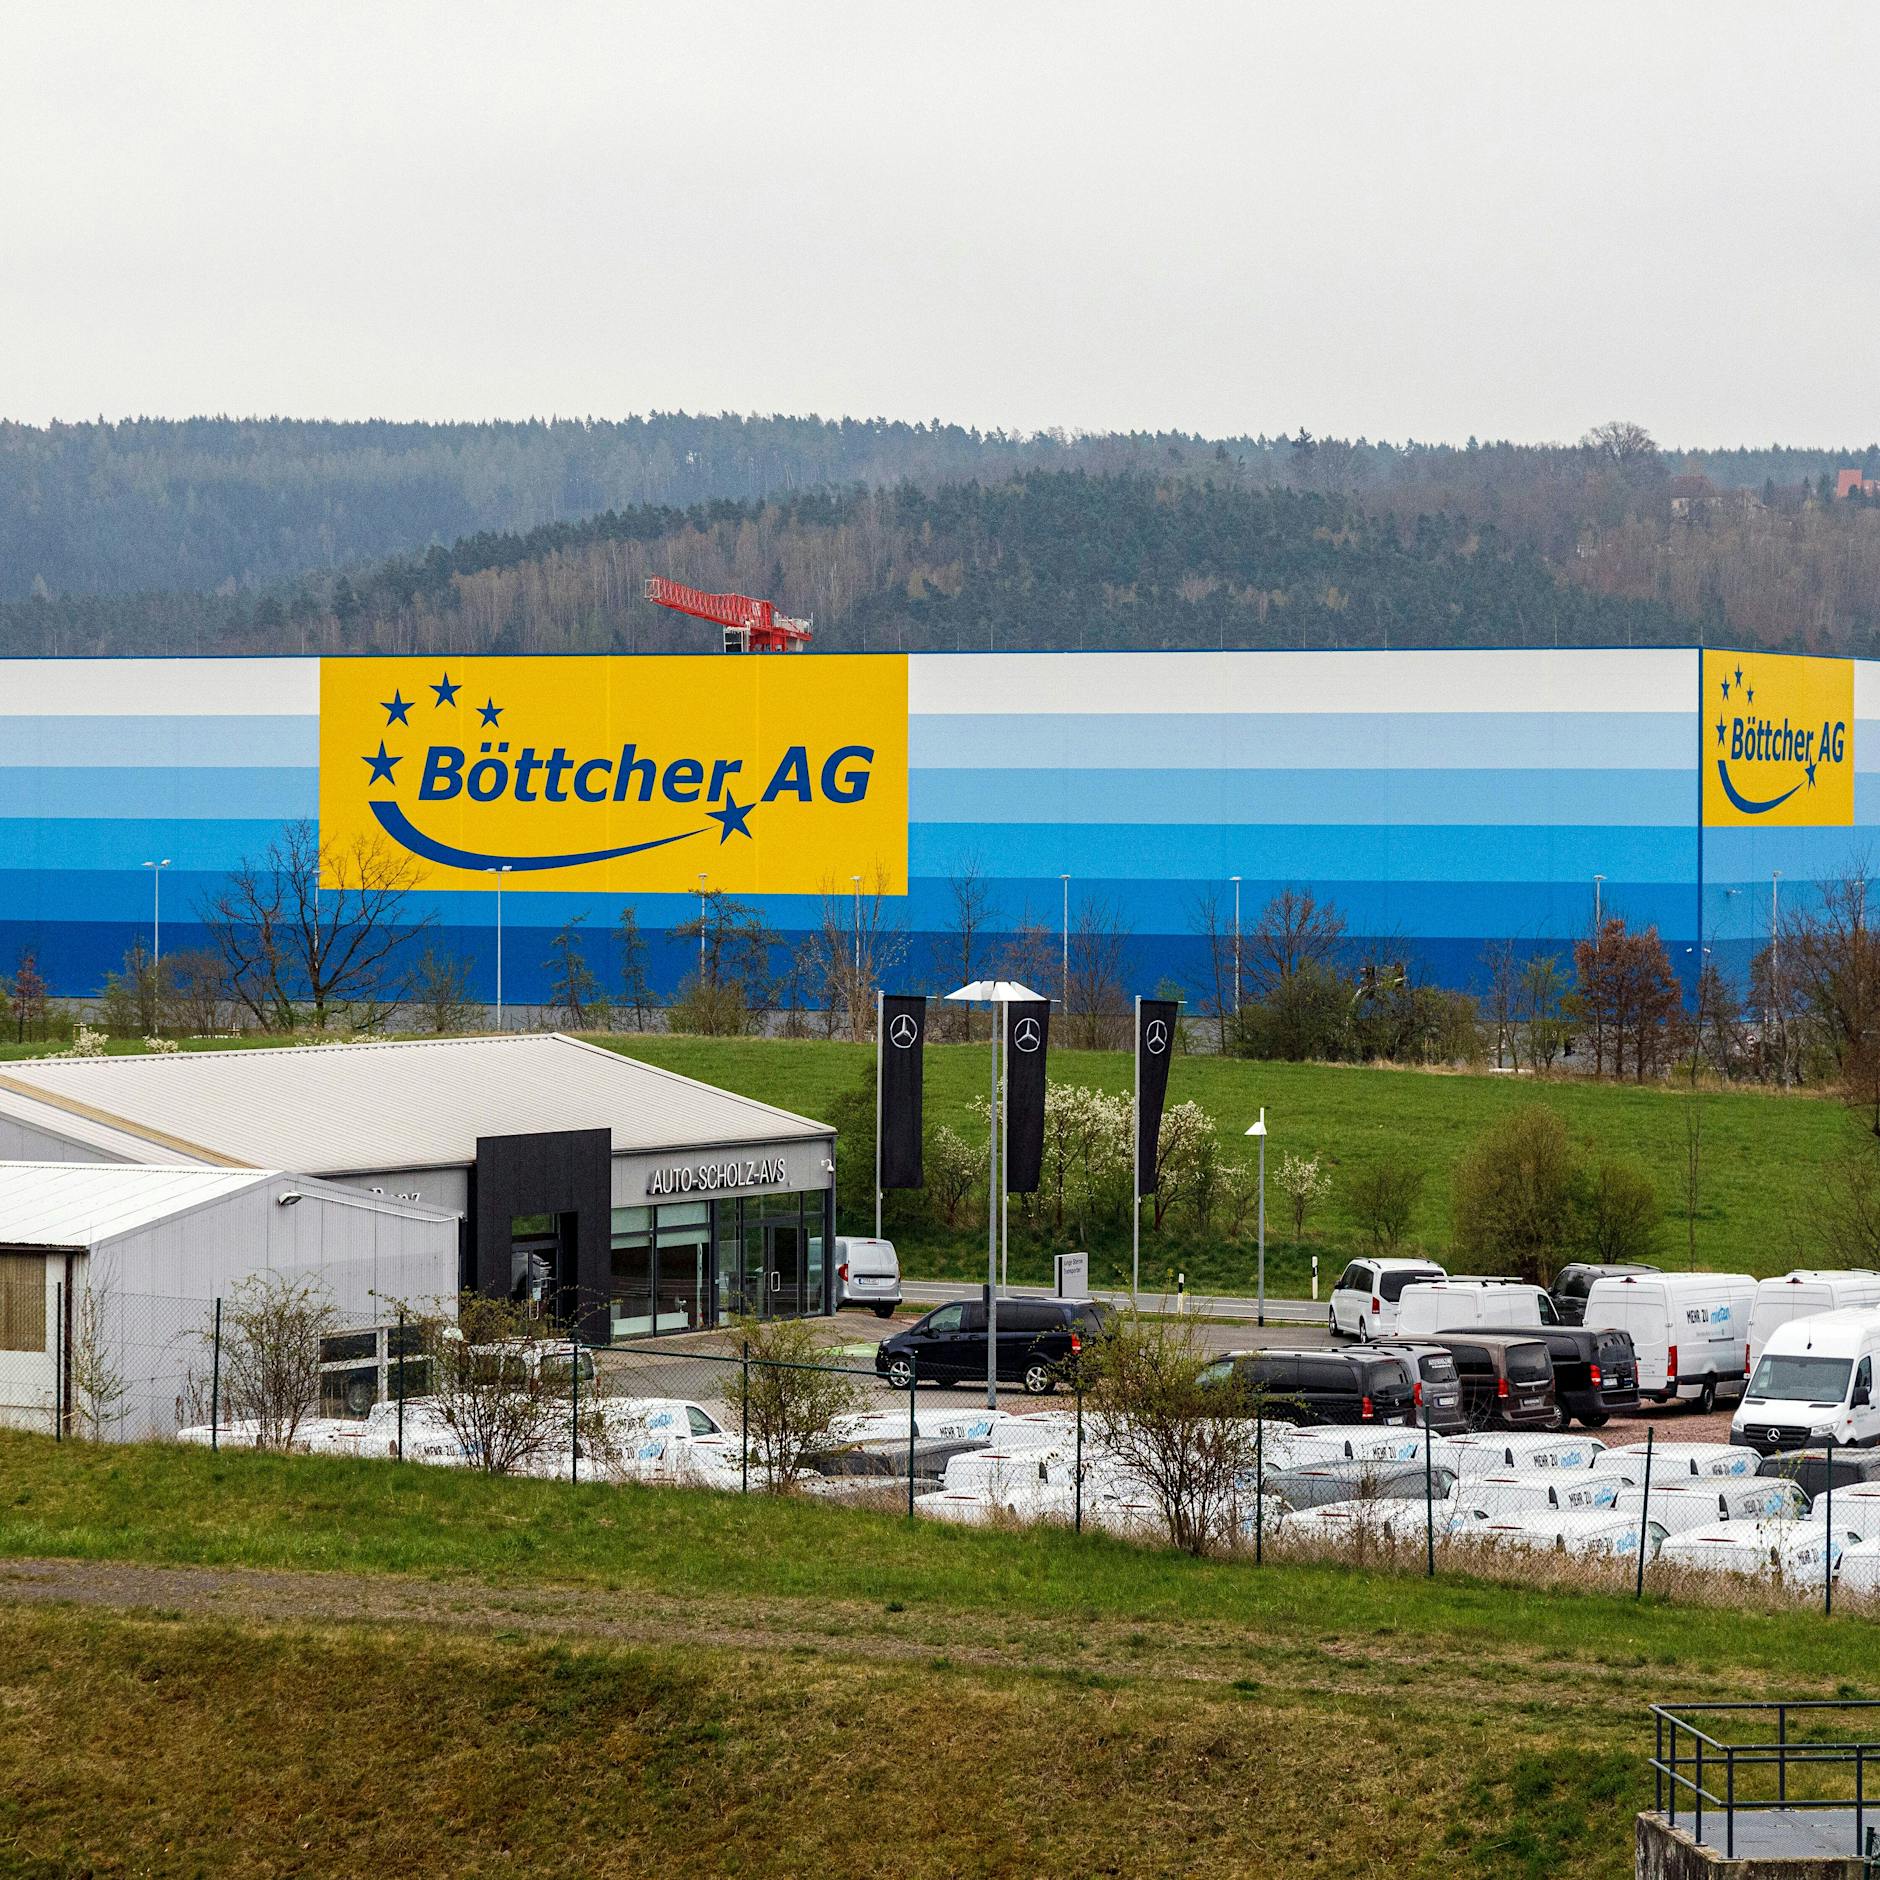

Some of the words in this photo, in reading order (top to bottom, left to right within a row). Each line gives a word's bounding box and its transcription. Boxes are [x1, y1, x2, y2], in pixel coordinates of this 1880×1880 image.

[1731, 716, 1814, 762] Böttcher
[1818, 720, 1846, 763] AG
[418, 741, 743, 803] Böttcher
[760, 745, 876, 804] AG
[652, 1157, 786, 1195] AUTO-SCHOLZ-AVS
